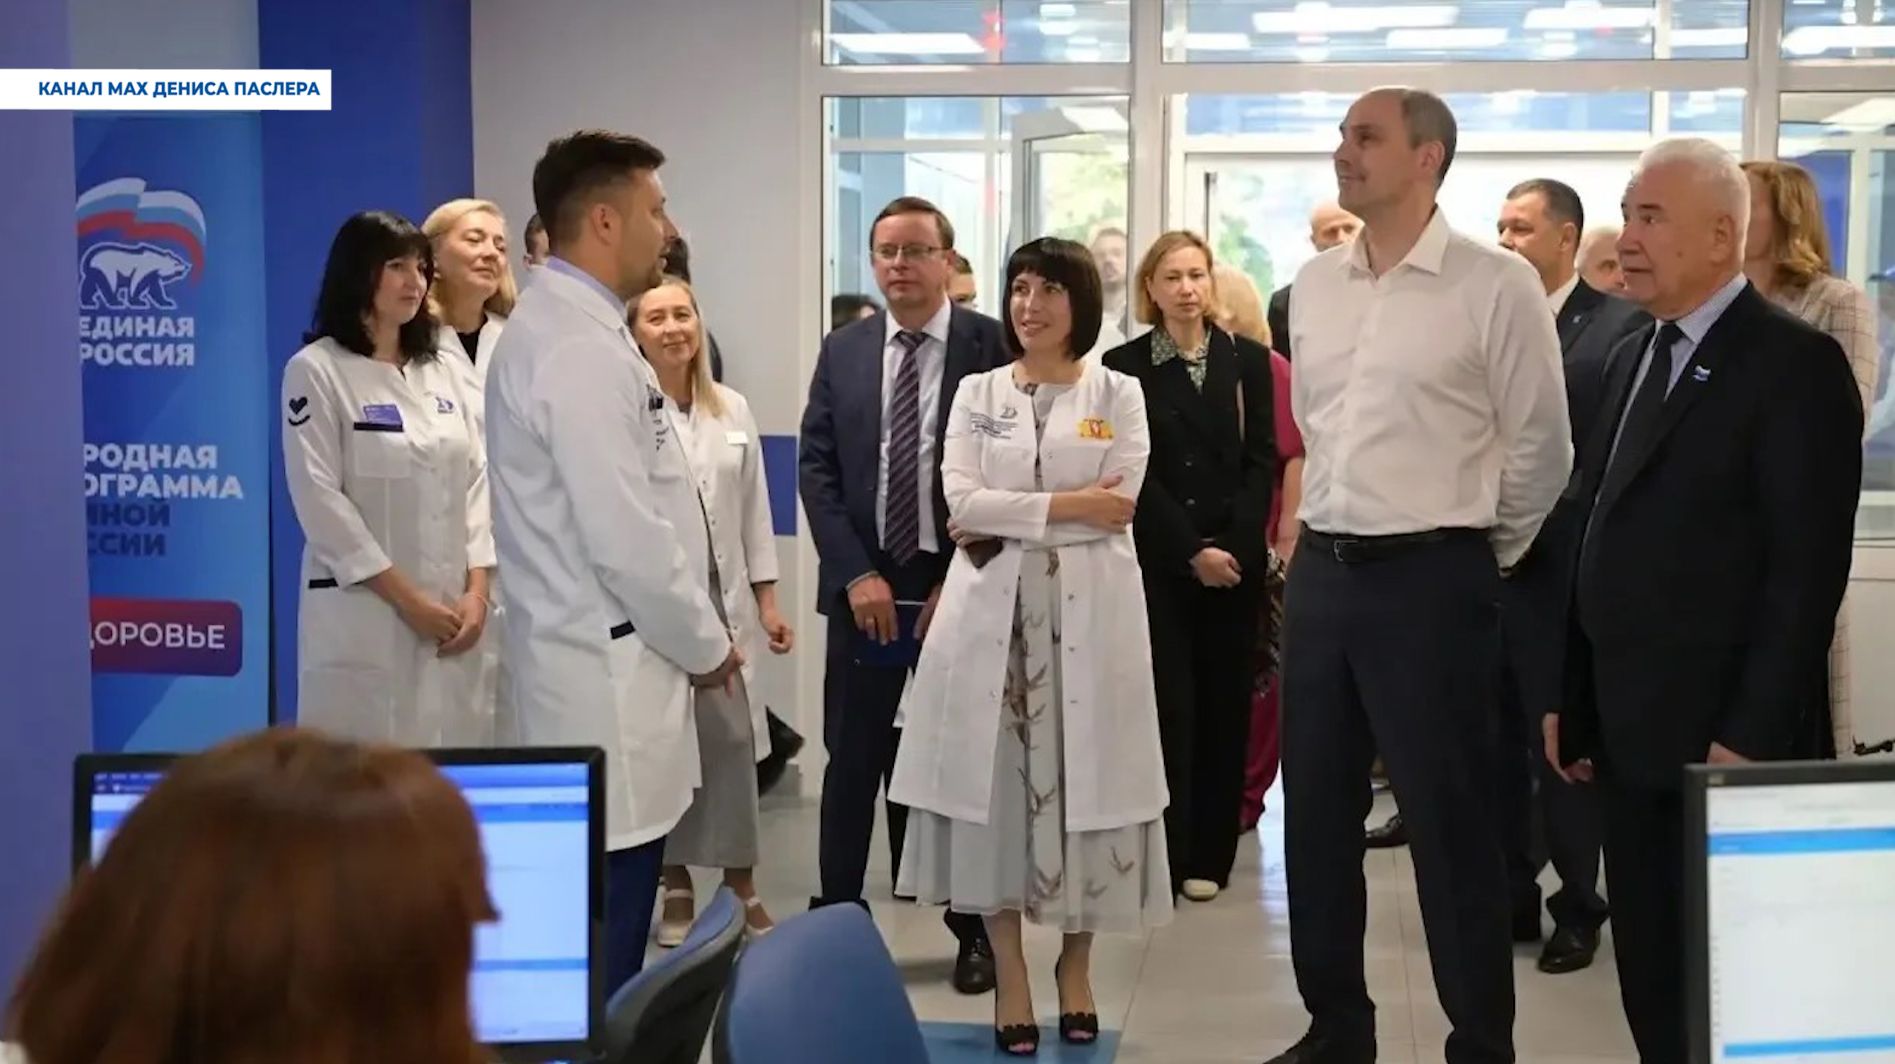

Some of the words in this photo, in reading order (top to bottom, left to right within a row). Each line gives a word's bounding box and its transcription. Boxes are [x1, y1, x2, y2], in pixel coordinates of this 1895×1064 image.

[80, 316, 194, 340] ЕДИНАЯ
[80, 343, 194, 366] РОССИЯ
[84, 443, 218, 472] РОДНАЯ
[90, 621, 225, 649] ОРОВЬЕ
